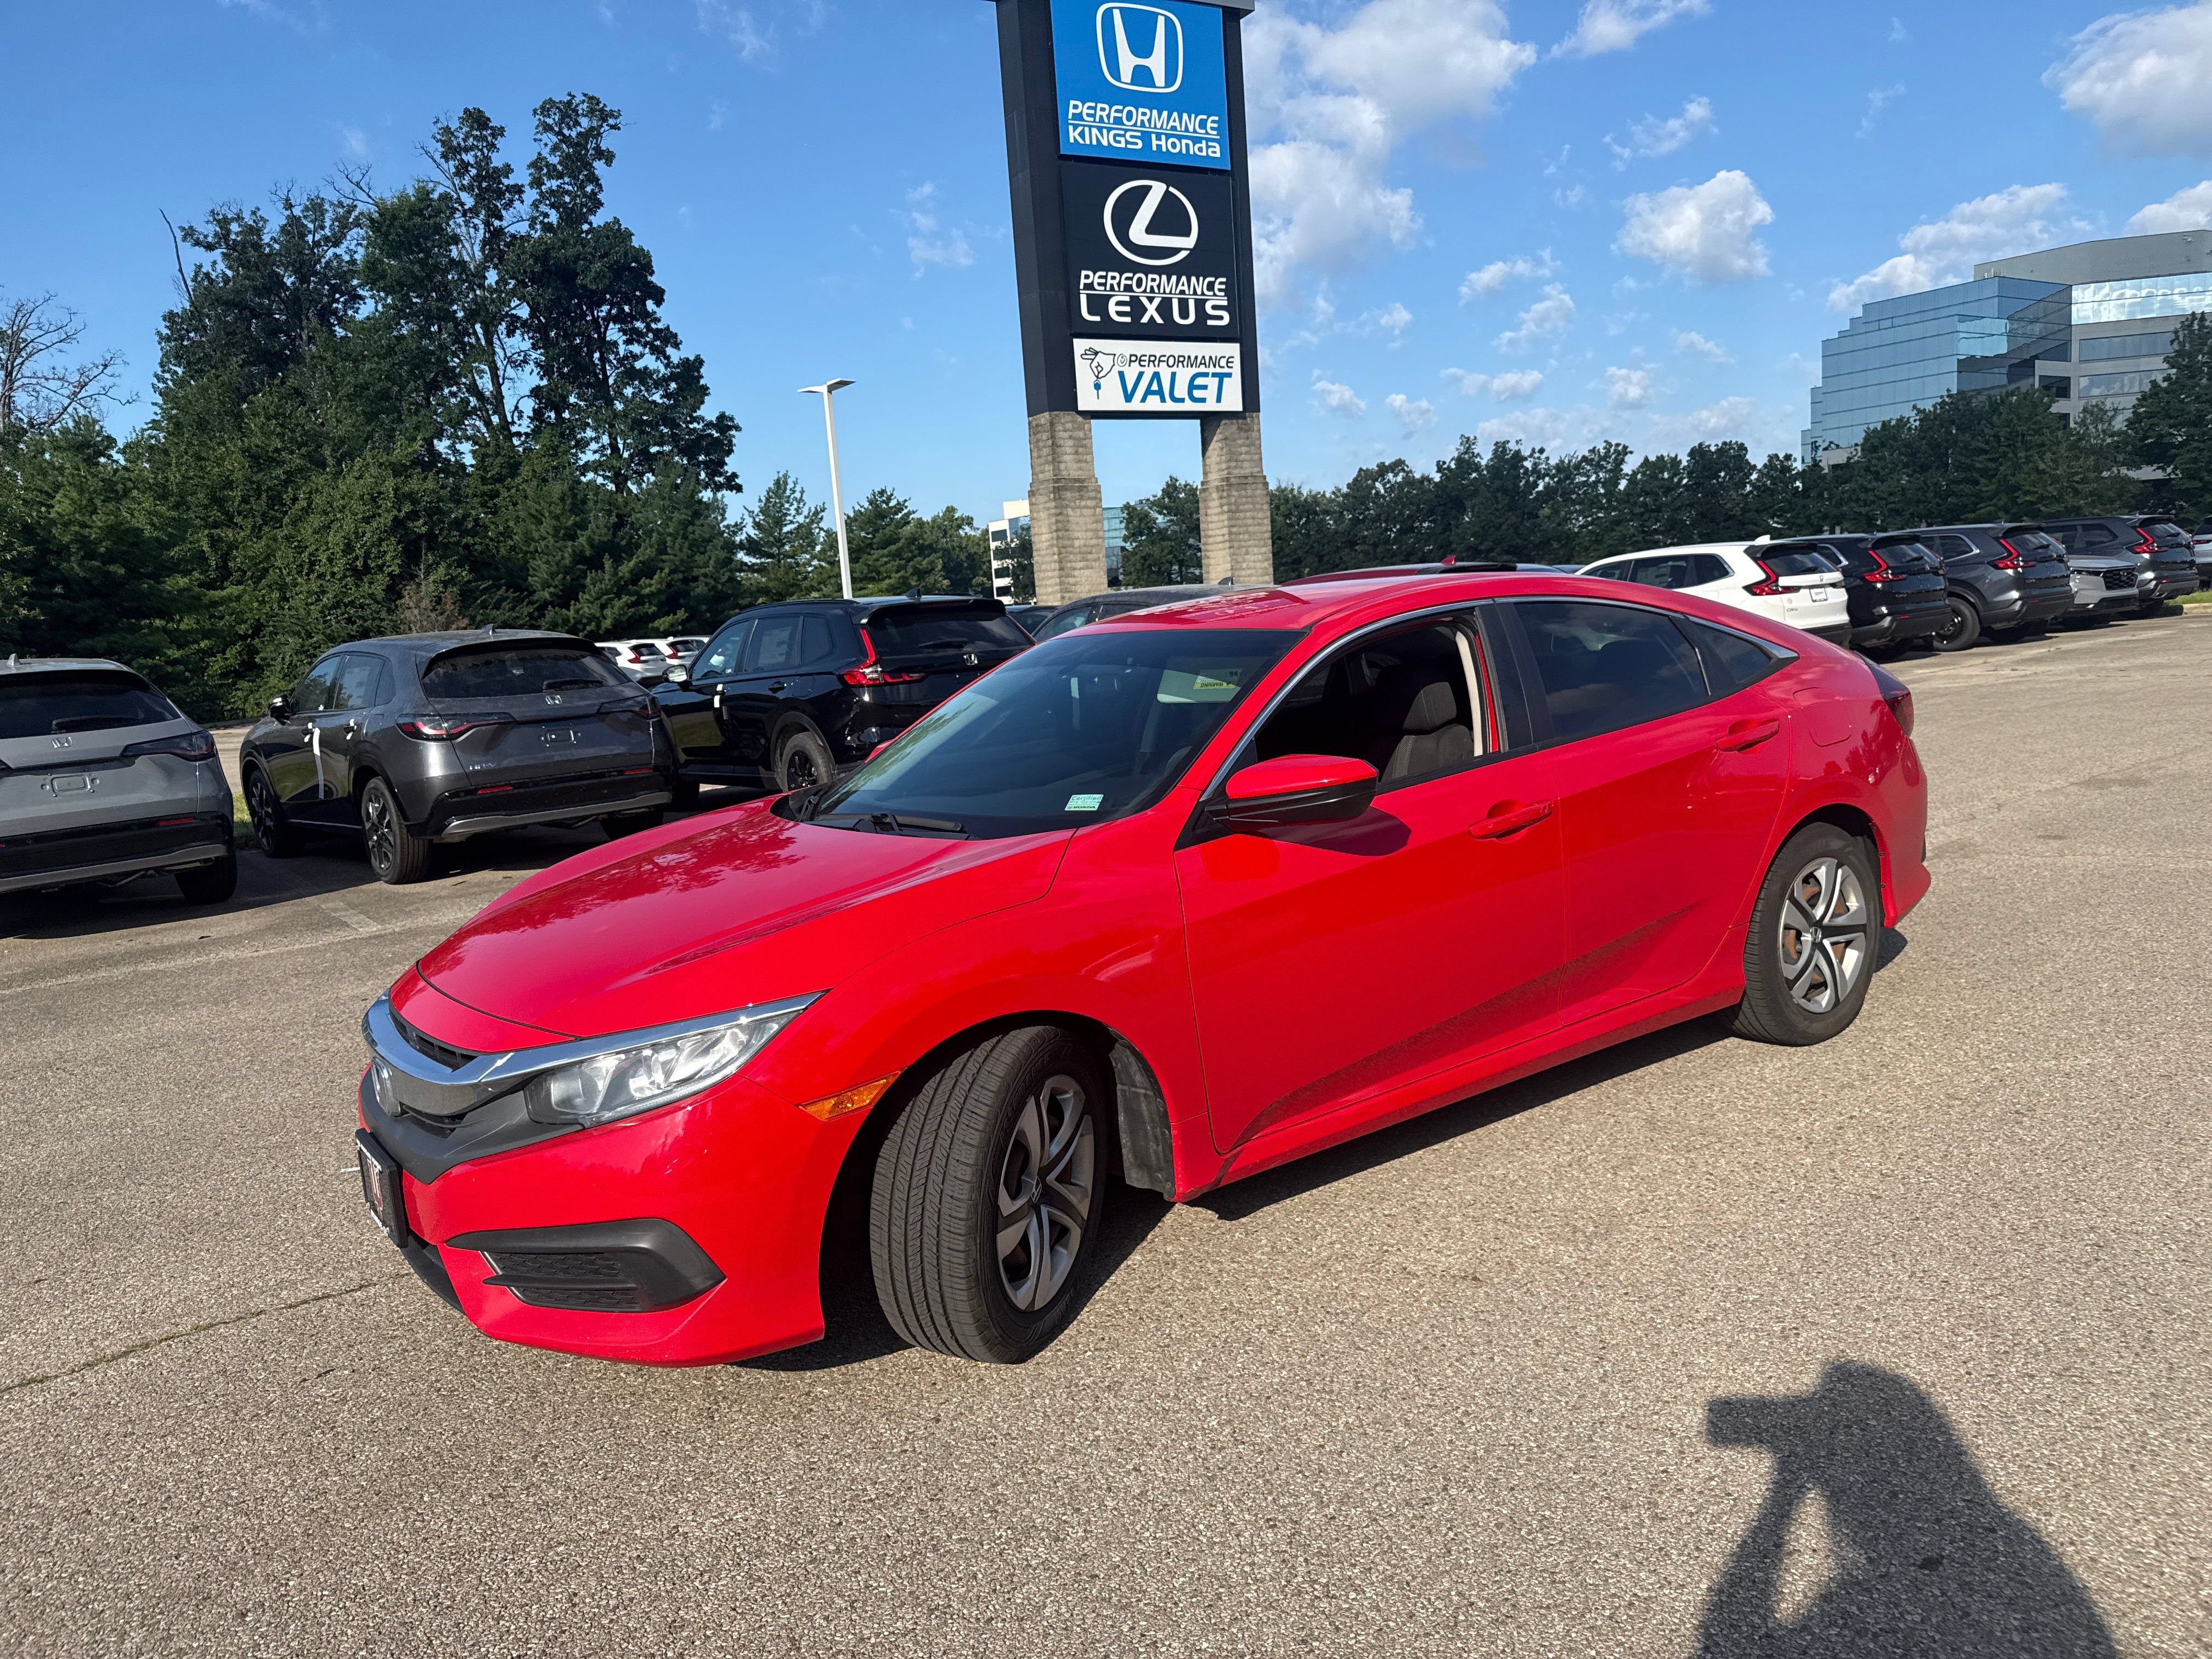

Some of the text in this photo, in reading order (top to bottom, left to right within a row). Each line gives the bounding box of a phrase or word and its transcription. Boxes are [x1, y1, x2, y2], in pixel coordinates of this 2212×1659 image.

[1068, 100, 1219, 135] PERFORMANCE
[1069, 125, 1221, 158] KINGS Honda
[1080, 270, 1227, 296] PERFORMANCE
[1080, 294, 1230, 326] LEXUS
[1128, 354, 1235, 369] PERFORMANCE
[1118, 370, 1233, 403] VALET
